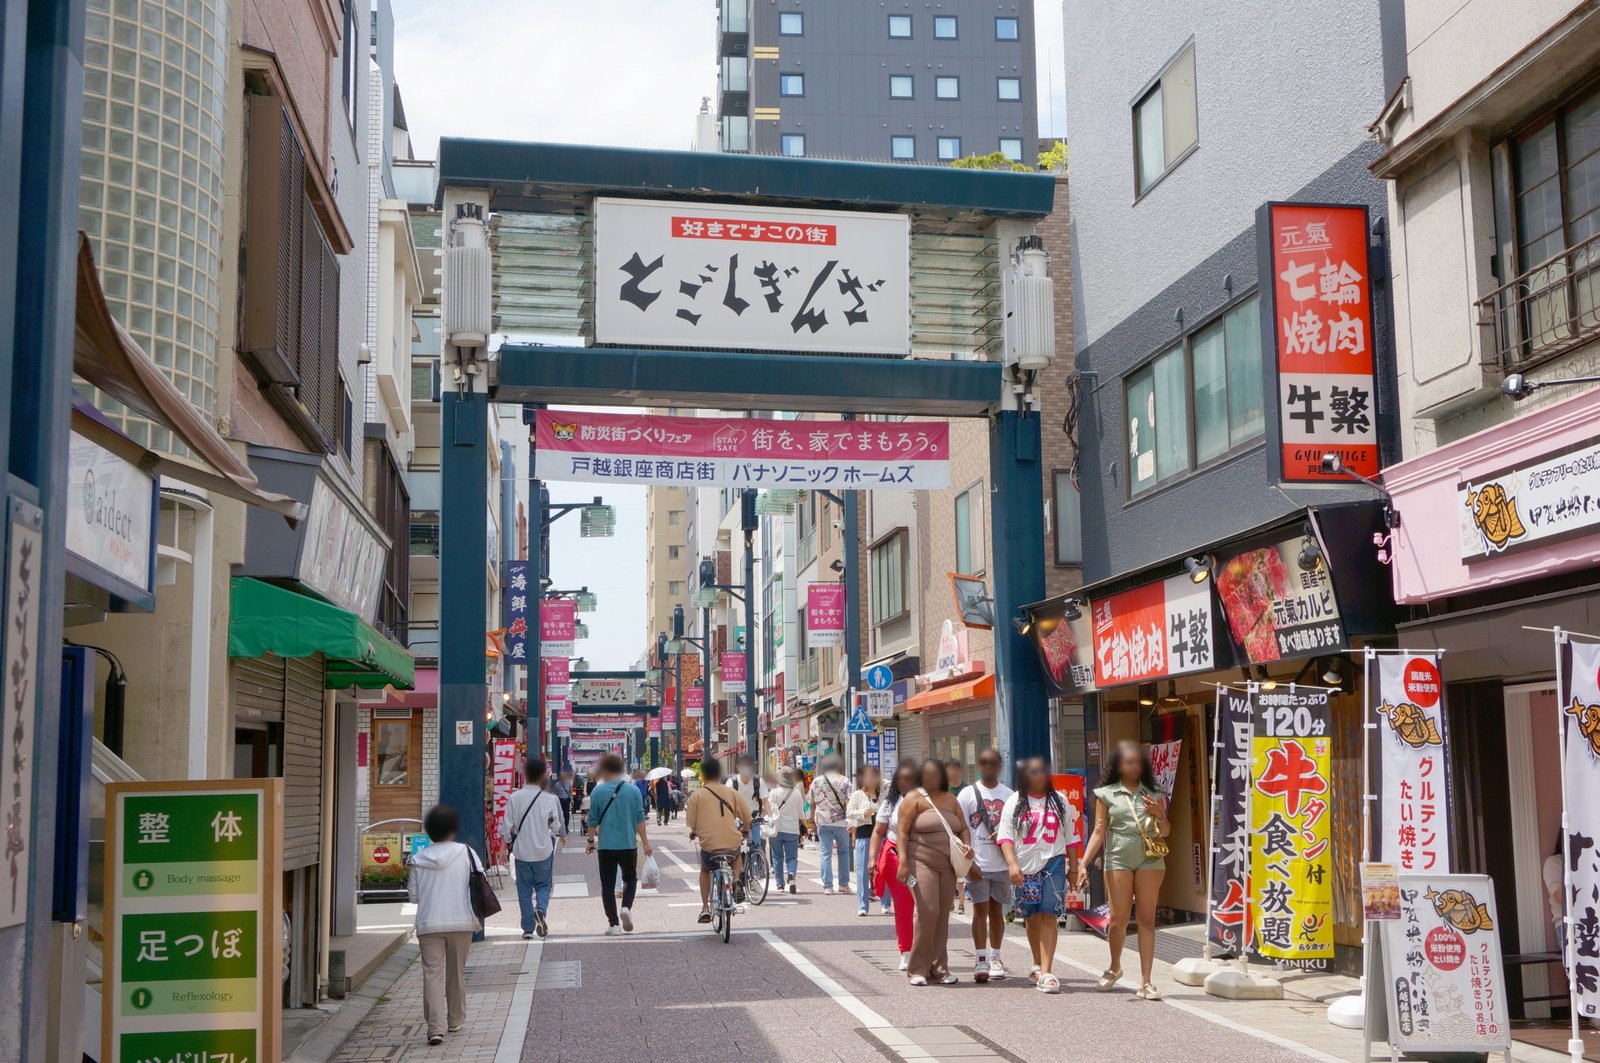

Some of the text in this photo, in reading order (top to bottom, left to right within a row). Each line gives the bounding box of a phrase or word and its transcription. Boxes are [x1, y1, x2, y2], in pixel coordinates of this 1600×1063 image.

[681, 219, 828, 243] 好きですこの街
[619, 252, 886, 334] とごしぎんざ
[1281, 258, 1363, 305] 七輪
[1284, 309, 1364, 355] 焼肉
[1287, 384, 1370, 434] 牛繁
[581, 425, 692, 444] 防災街づくりフェア
[752, 428, 938, 452] 街を、家でまもろう。
[571, 457, 715, 481] 戸越銀座商店街
[1300, 568, 1326, 590] 国産牛
[1273, 589, 1333, 626] 元氣カルビ
[1097, 622, 1164, 681] 七輪焼肉
[1170, 607, 1210, 668] 牛繁
[1279, 624, 1340, 654] 食べ放題あります
[1259, 694, 1328, 706] お時間たっぷり
[1262, 706, 1326, 737] 120分
[138, 811, 243, 843] 整体
[1398, 780, 1417, 869] たい焼き
[167, 874, 241, 884] Body massage
[1258, 813, 1298, 950] 食べ放題
[136, 930, 243, 963] 足つぼ
[1430, 944, 1462, 953] 米粉使用
[1433, 933, 1457, 942] 100%
[1433, 955, 1460, 964] たい焼き
[172, 992, 234, 1004] Reflexology
[1469, 955, 1487, 1036] たい焼きのお店
[1480, 942, 1498, 1035] グルテンフリーの
